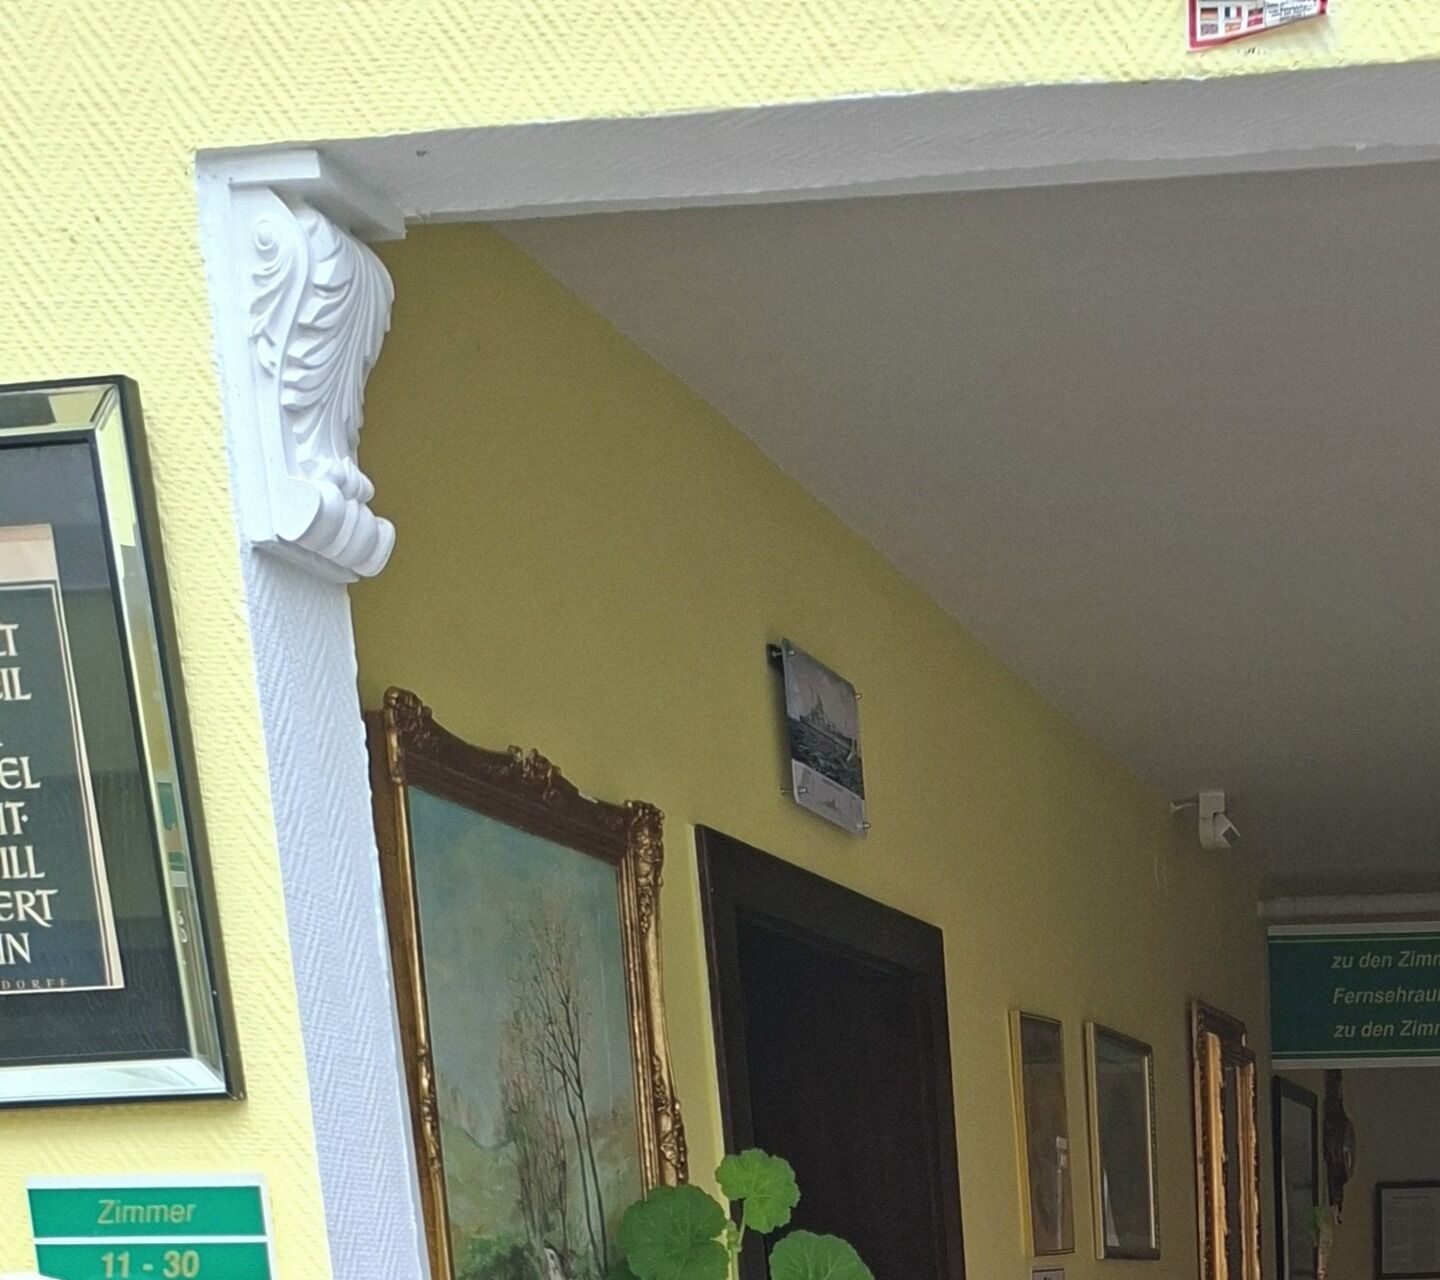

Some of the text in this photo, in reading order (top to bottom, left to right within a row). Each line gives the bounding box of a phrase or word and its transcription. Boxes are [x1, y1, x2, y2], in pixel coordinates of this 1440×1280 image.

[1331, 955, 1353, 969] zu
[1359, 951, 1392, 968] den
[1333, 1024, 1357, 1038] zu
[1360, 1021, 1394, 1037] den
[97, 1199, 197, 1224] Zimmer
[101, 1251, 130, 1279] 11
[162, 1249, 200, 1279] 30
